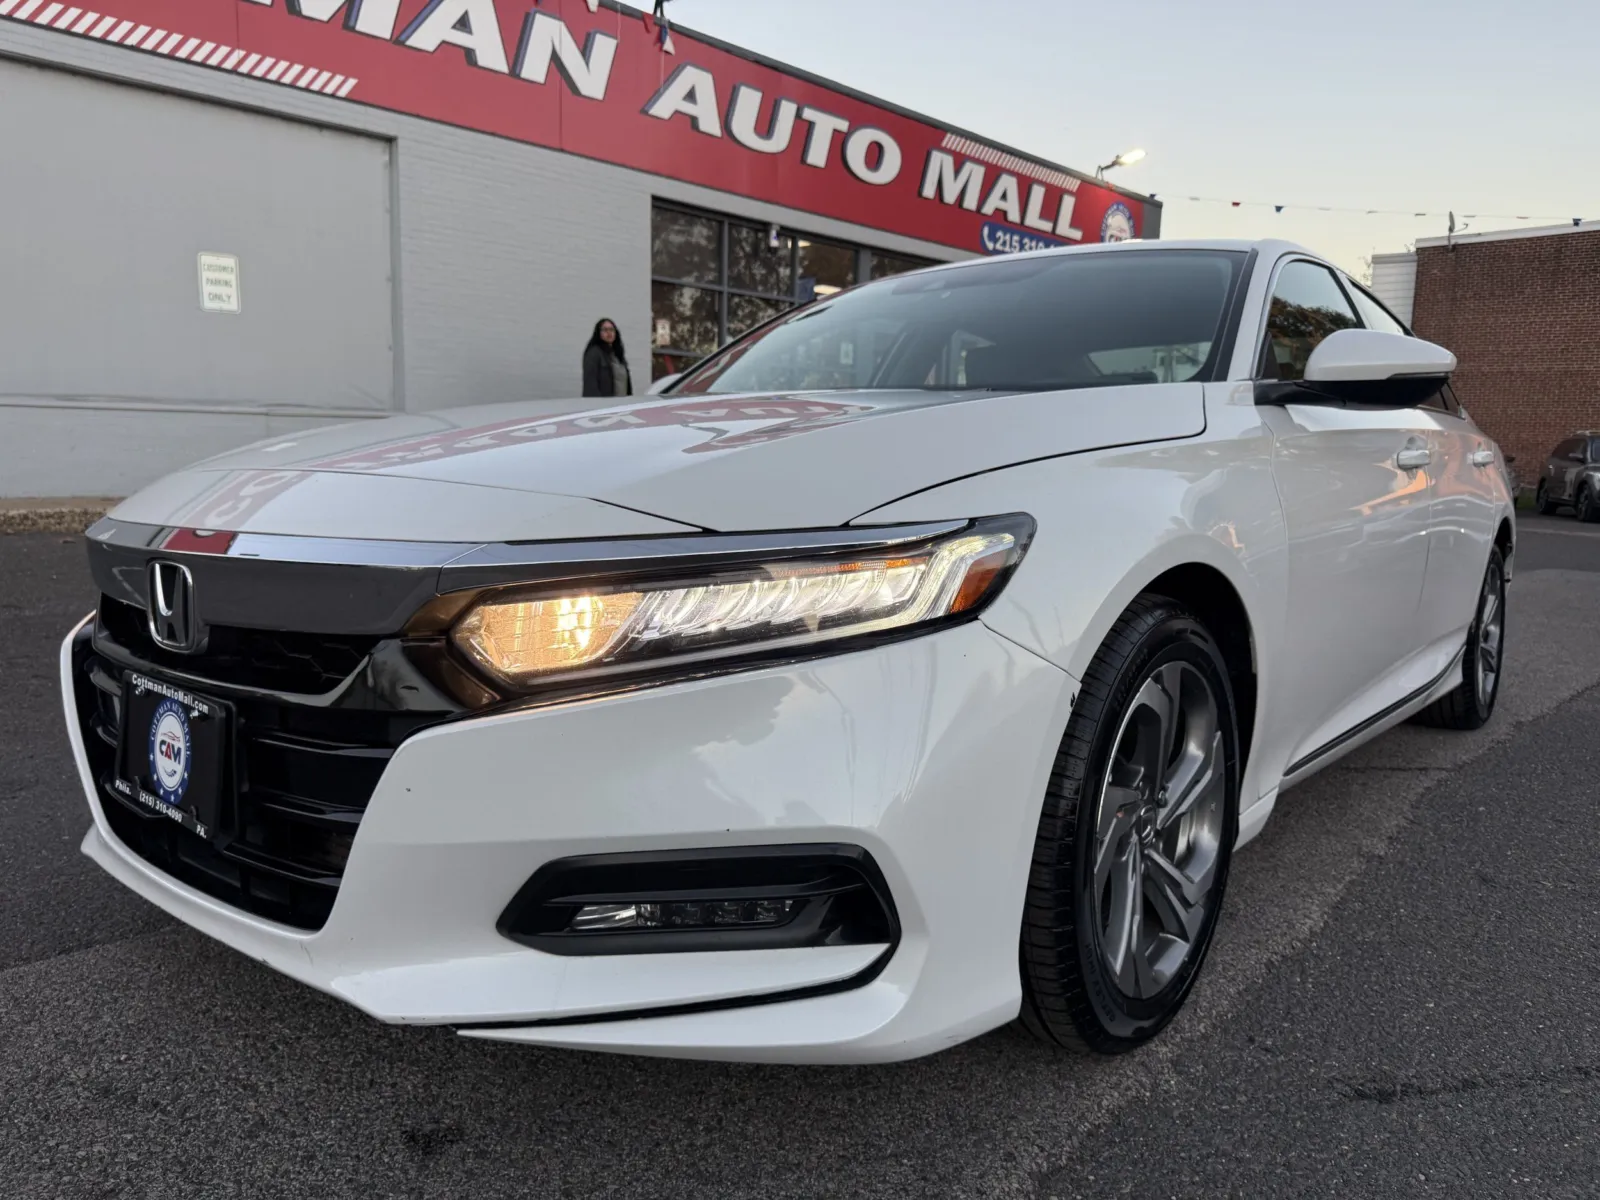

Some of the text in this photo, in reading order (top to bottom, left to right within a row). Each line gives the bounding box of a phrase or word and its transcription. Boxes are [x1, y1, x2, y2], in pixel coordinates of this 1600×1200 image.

[240, 0, 1083, 241] AN AUTO MALL
[995, 230, 1020, 253] 215
[208, 291, 231, 304] ONLY
[132, 673, 209, 714] CottmanAutoMall.com
[159, 739, 182, 765] CAM
[115, 779, 207, 839] Phila. (215) 310-4090 PA.
